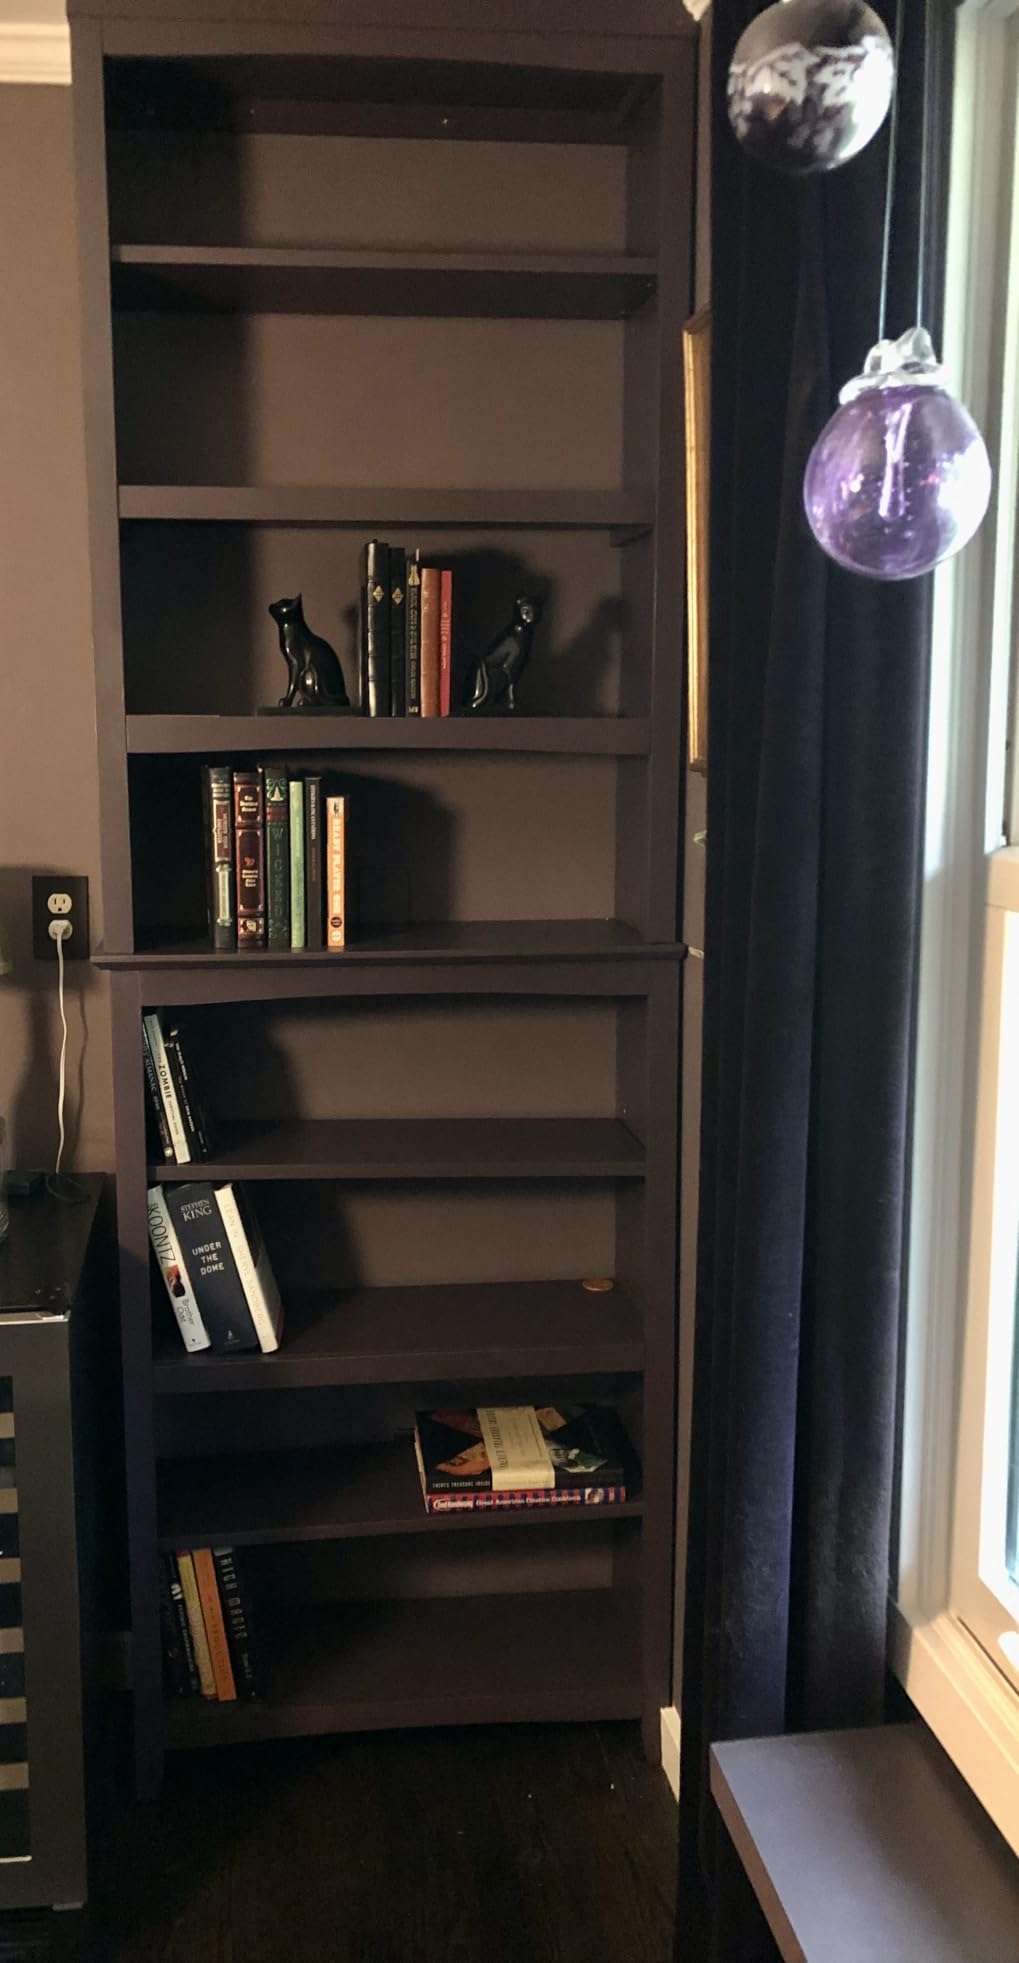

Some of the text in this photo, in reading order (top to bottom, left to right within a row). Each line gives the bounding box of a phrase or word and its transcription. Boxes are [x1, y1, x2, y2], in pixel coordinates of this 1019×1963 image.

[271, 826, 286, 917] WICKED
[332, 854, 341, 891] PLAYER
[145, 1059, 158, 1094] ALMANAC
[158, 1064, 172, 1099] ZOMBIE
[180, 1199, 210, 1213] STEPHEN
[182, 1206, 213, 1222] KING
[148, 1204, 176, 1265] KOONTZ
[191, 1240, 222, 1257] UNDER
[200, 1253, 219, 1266] THE
[200, 1262, 225, 1276] DOME
[175, 1306, 187, 1323] Odd
[181, 1298, 195, 1326] Brother
